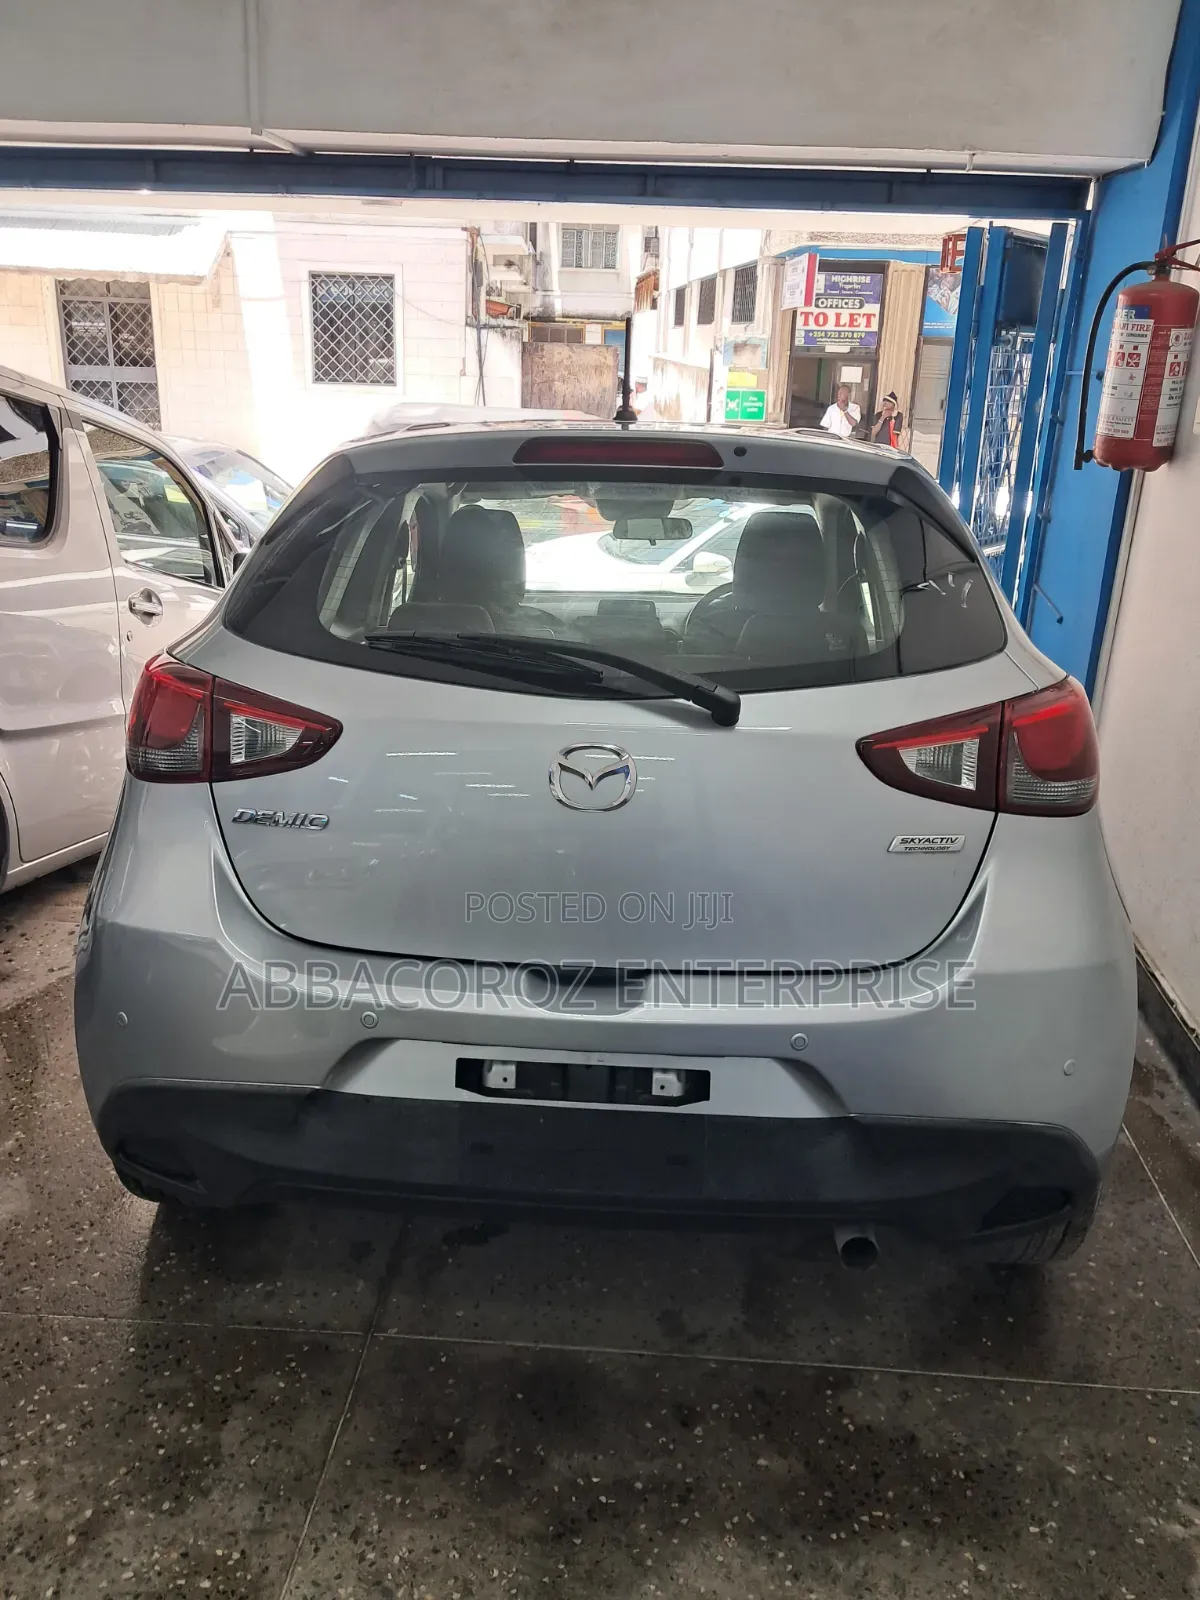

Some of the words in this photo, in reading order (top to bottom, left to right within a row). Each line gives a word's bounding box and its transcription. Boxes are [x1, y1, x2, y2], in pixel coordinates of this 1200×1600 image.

[831, 275, 871, 284] HIGHRISE
[818, 298, 861, 309] OFFICES
[800, 311, 829, 327] TO
[834, 312, 876, 329] LET
[1130, 323, 1152, 332] FIRE
[231, 807, 330, 830] DEMIO
[899, 836, 960, 845] SKYACTIV
